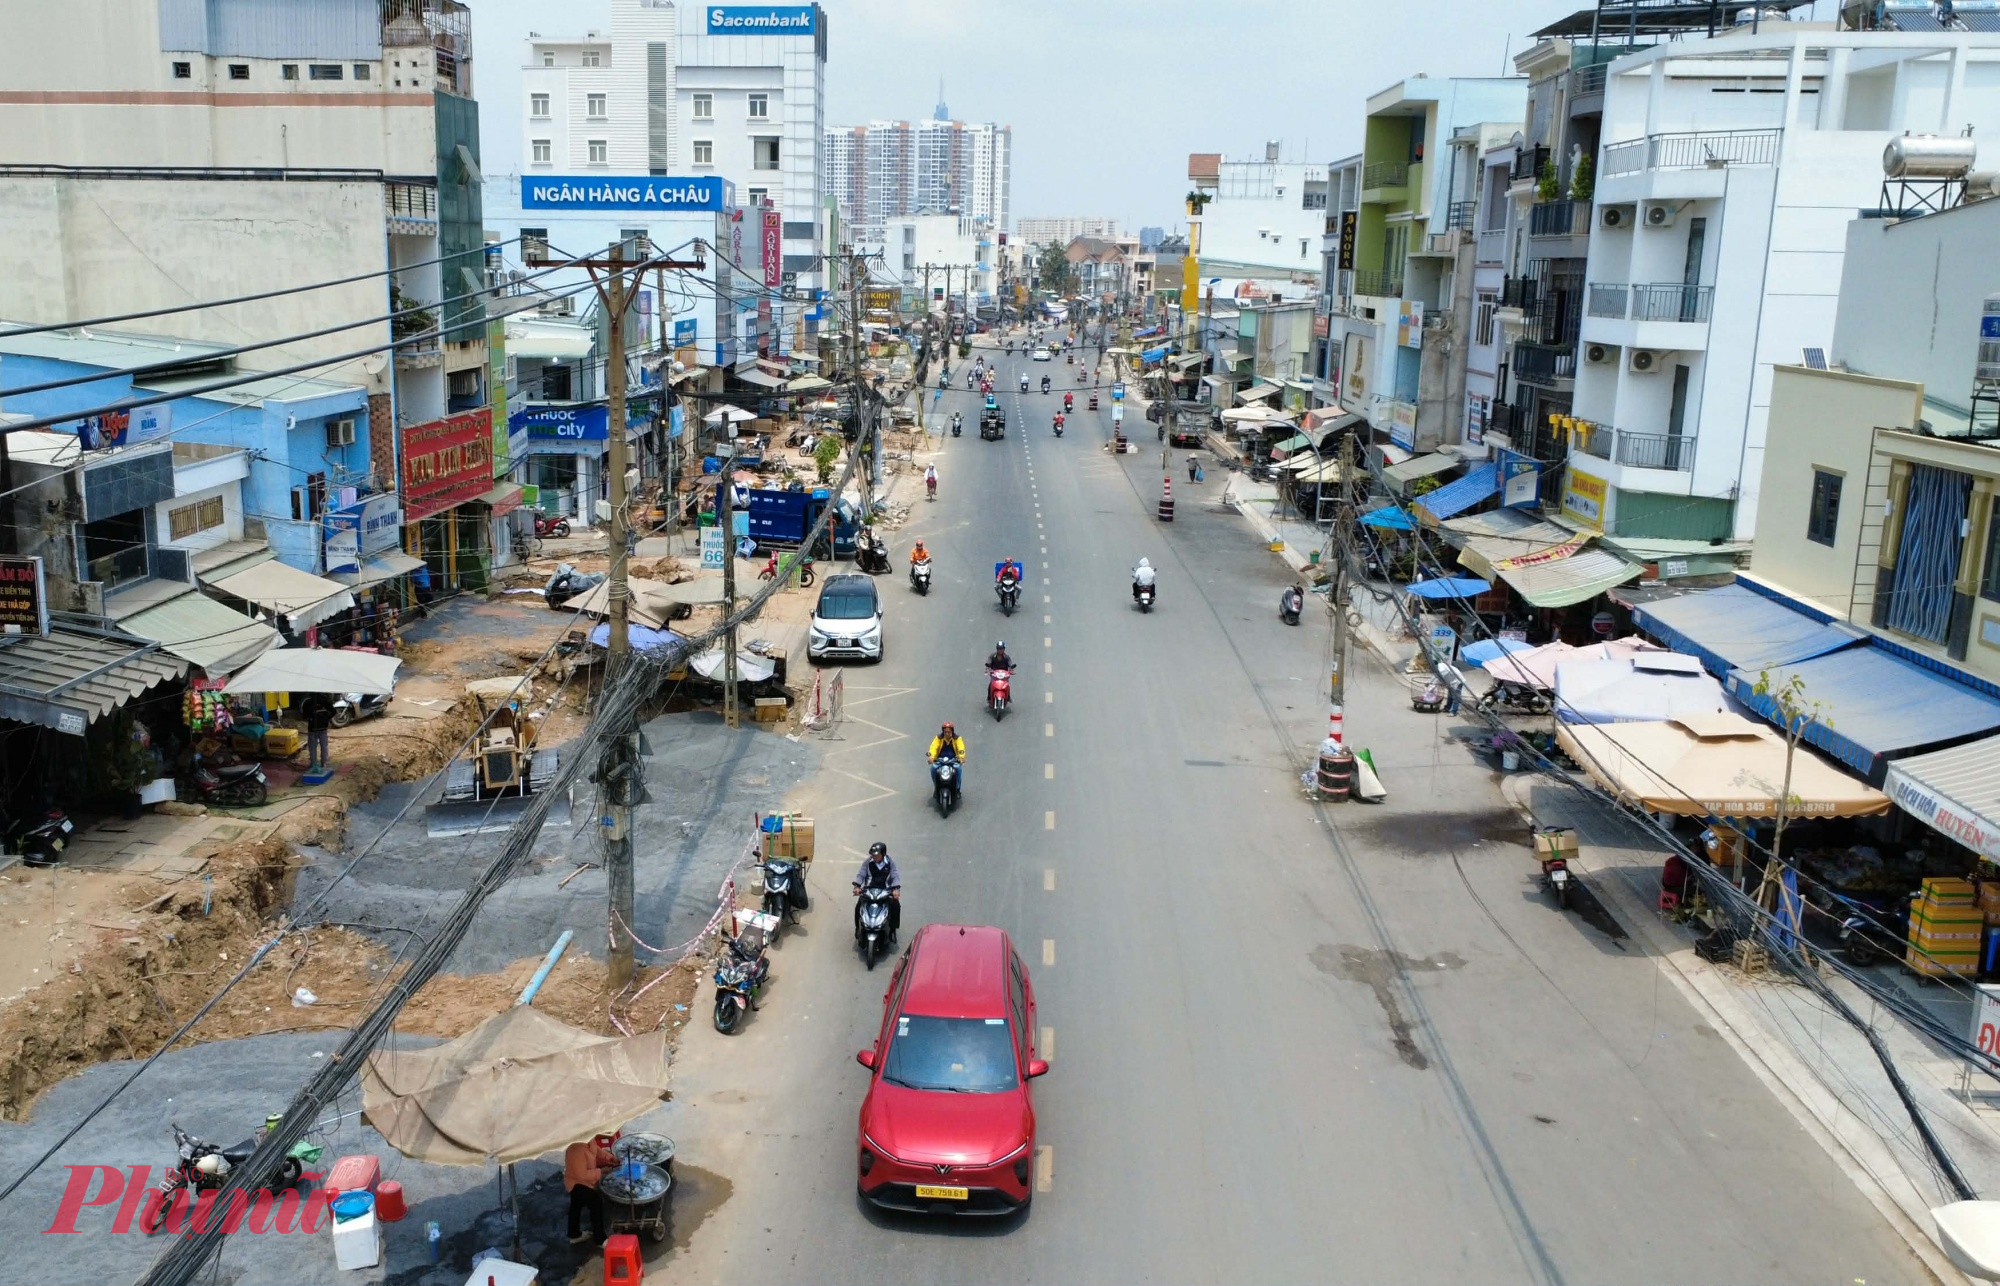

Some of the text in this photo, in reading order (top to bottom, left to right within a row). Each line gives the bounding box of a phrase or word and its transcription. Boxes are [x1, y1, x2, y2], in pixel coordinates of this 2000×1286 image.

[711, 9, 810, 27] Sacombank
[533, 183, 710, 204] NGÂN HÀNG Á CHÂU
[766, 230, 776, 283] AGRIBANK
[1342, 228, 1353, 268] AMORA
[101, 411, 129, 440] Tiger
[704, 550, 724, 563] 66
[1434, 629, 1452, 637] 339
[1746, 801, 1766, 812] 345
[1935, 807, 1985, 848] HUYỀN
